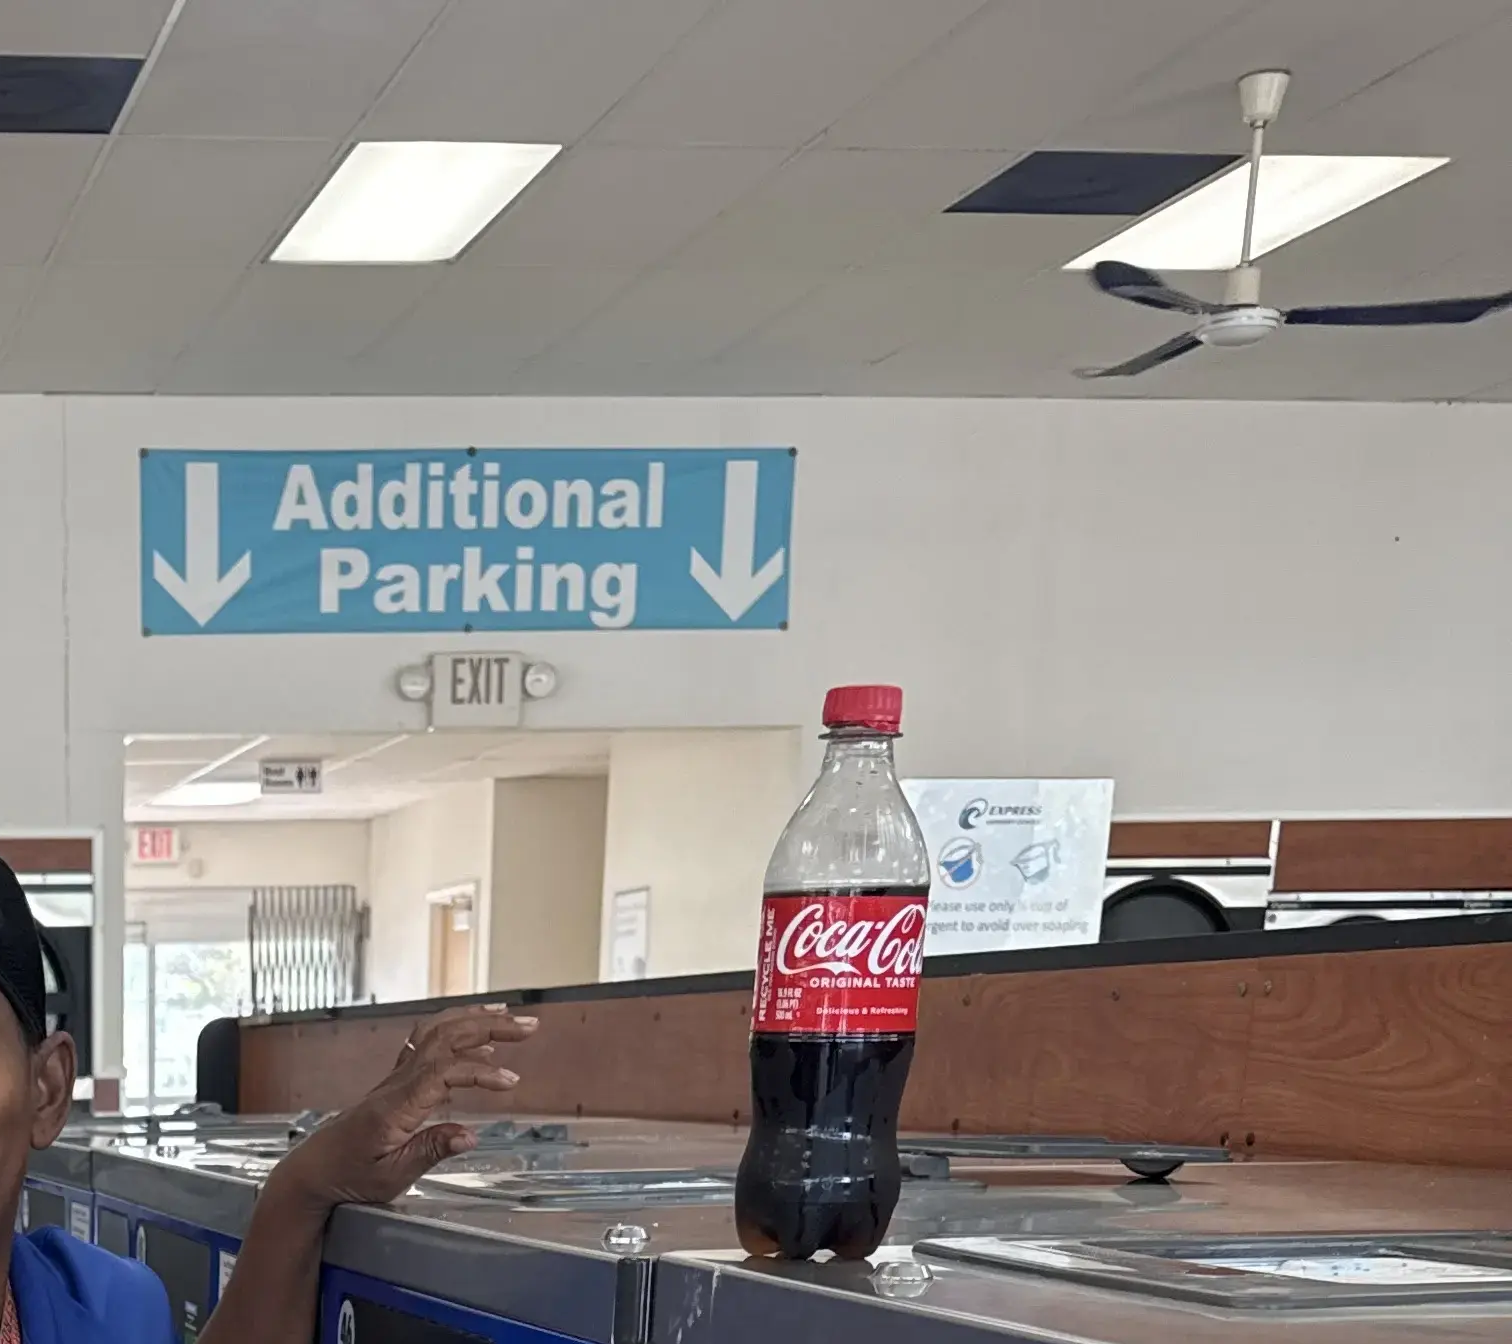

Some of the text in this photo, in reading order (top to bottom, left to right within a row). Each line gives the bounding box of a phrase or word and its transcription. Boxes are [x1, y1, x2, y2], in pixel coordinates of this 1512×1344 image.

[272, 462, 665, 531] Additional
[319, 546, 638, 629] Parking
[451, 658, 510, 705] EXIT
[989, 805, 1042, 816] EXPRESS
[138, 828, 173, 860] EXIT
[965, 903, 986, 912] use
[988, 900, 1014, 914] only
[1055, 899, 1068, 912] of
[961, 919, 1088, 934] to avoid over soaping
[759, 942, 773, 1021] RECYCLE
[766, 908, 776, 934] ME
[810, 977, 915, 988] ORIGINAL TASTE
[816, 1007, 908, 1015] Delicious & Refreshing
